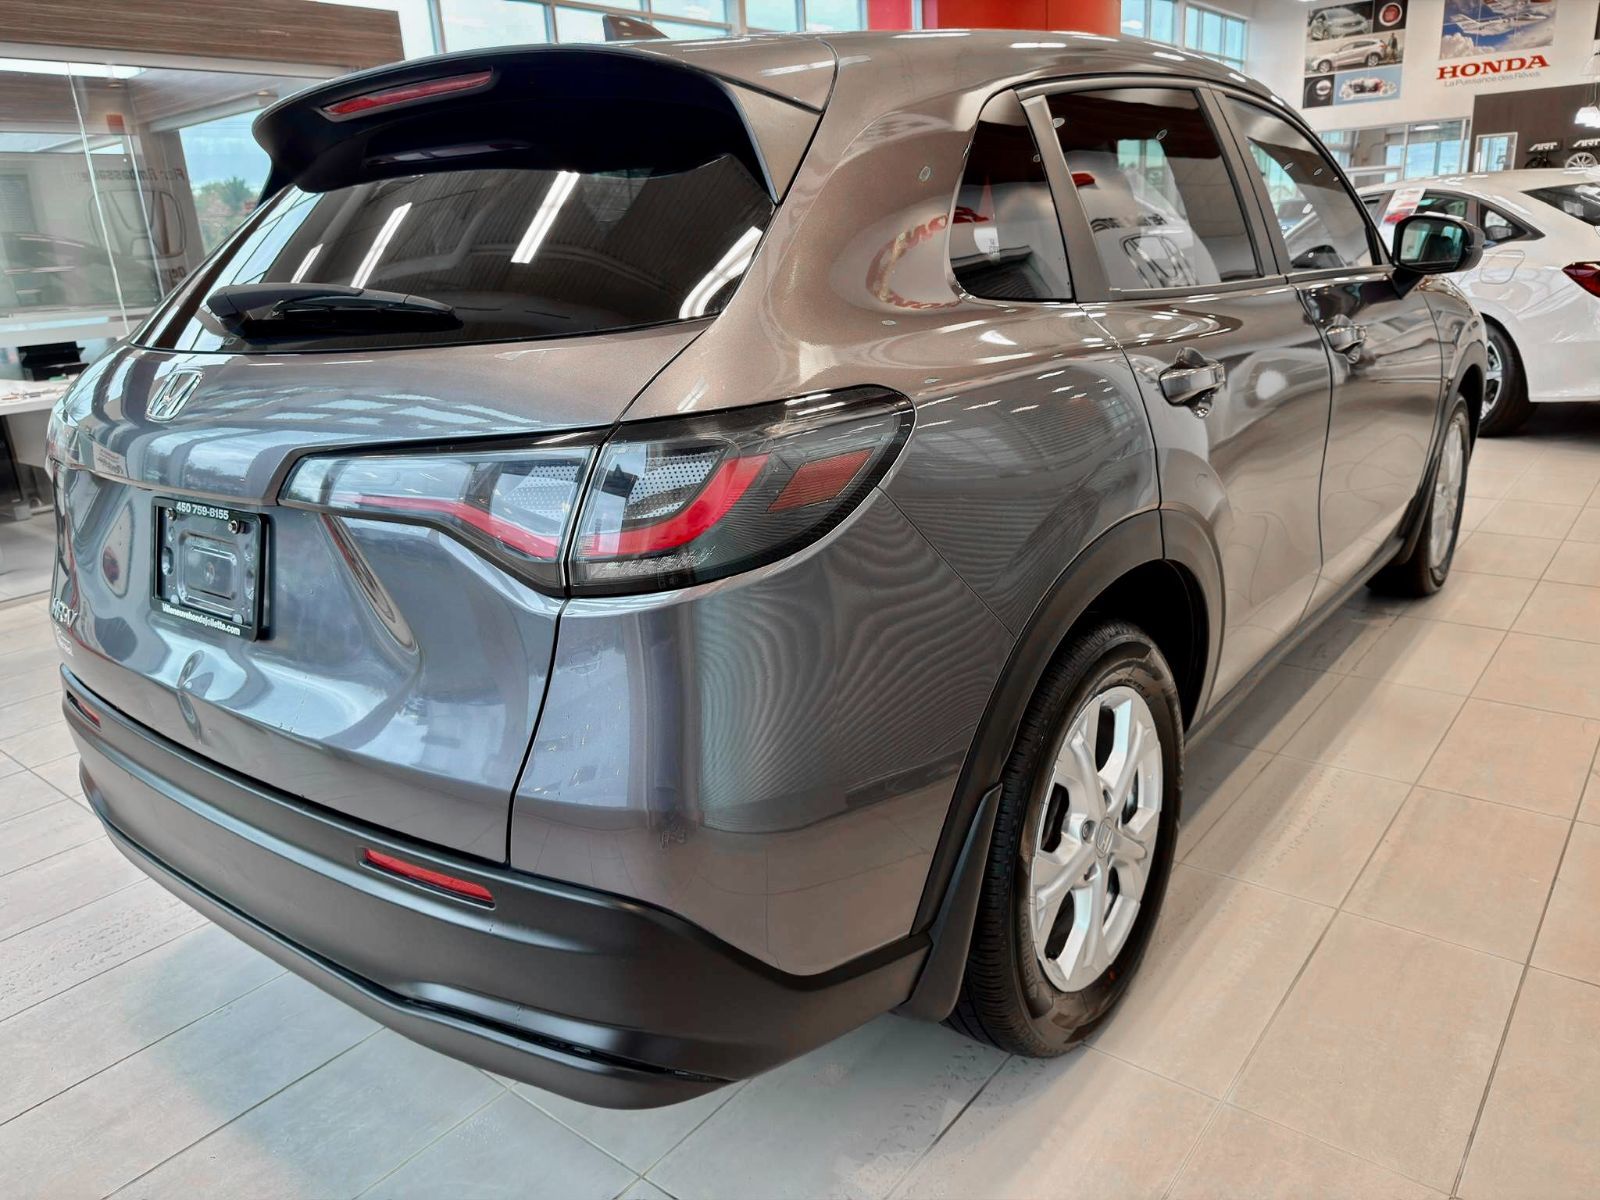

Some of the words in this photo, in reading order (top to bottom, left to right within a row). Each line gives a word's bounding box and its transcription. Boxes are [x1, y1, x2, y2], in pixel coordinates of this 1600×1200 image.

[1436, 54, 1551, 80] HONDA
[176, 501, 191, 513] 450
[192, 504, 230, 521] 759-8155
